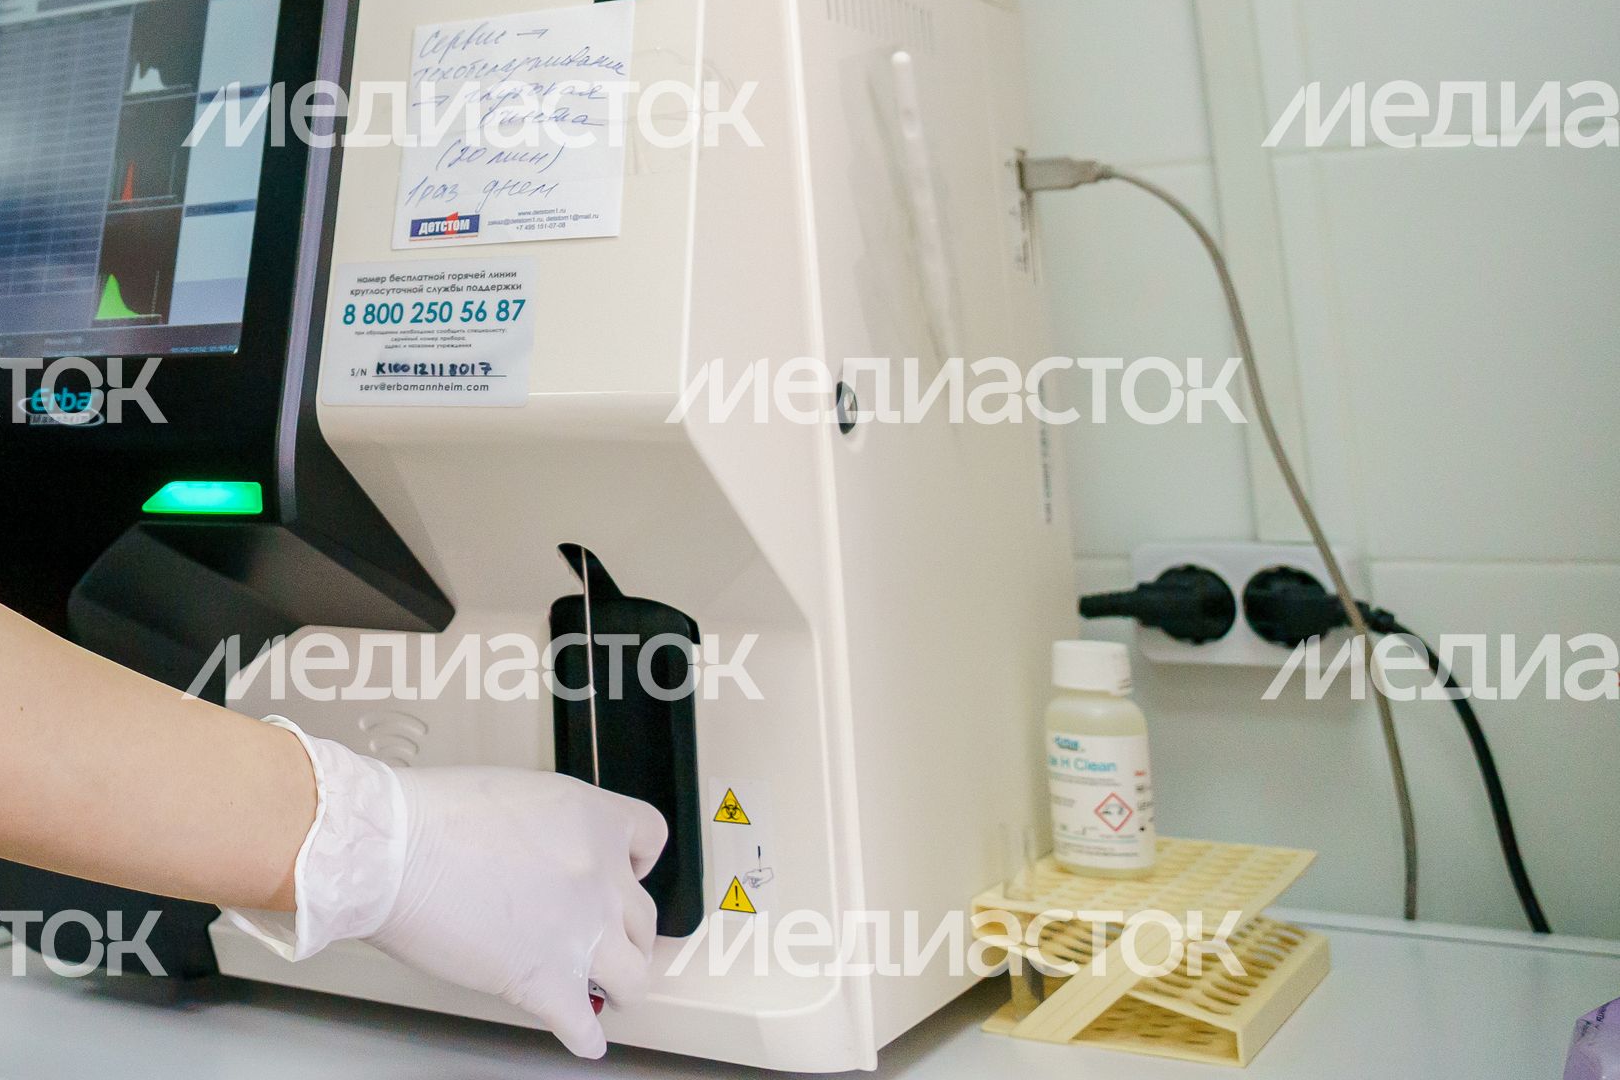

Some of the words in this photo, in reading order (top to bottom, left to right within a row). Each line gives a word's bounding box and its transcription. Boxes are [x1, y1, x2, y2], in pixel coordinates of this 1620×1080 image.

[357, 276, 386, 285] номер
[389, 272, 444, 283] бесплатной
[448, 271, 485, 281] горячей
[488, 270, 517, 278] линии
[350, 285, 423, 296] круглосуточной
[426, 283, 463, 294] службы
[466, 283, 521, 293] поддержки
[343, 303, 356, 325] 8
[362, 302, 404, 324] 800
[410, 301, 453, 323] 250
[460, 300, 487, 322] 56
[495, 299, 526, 321] 87
[350, 368, 367, 377] S/N
